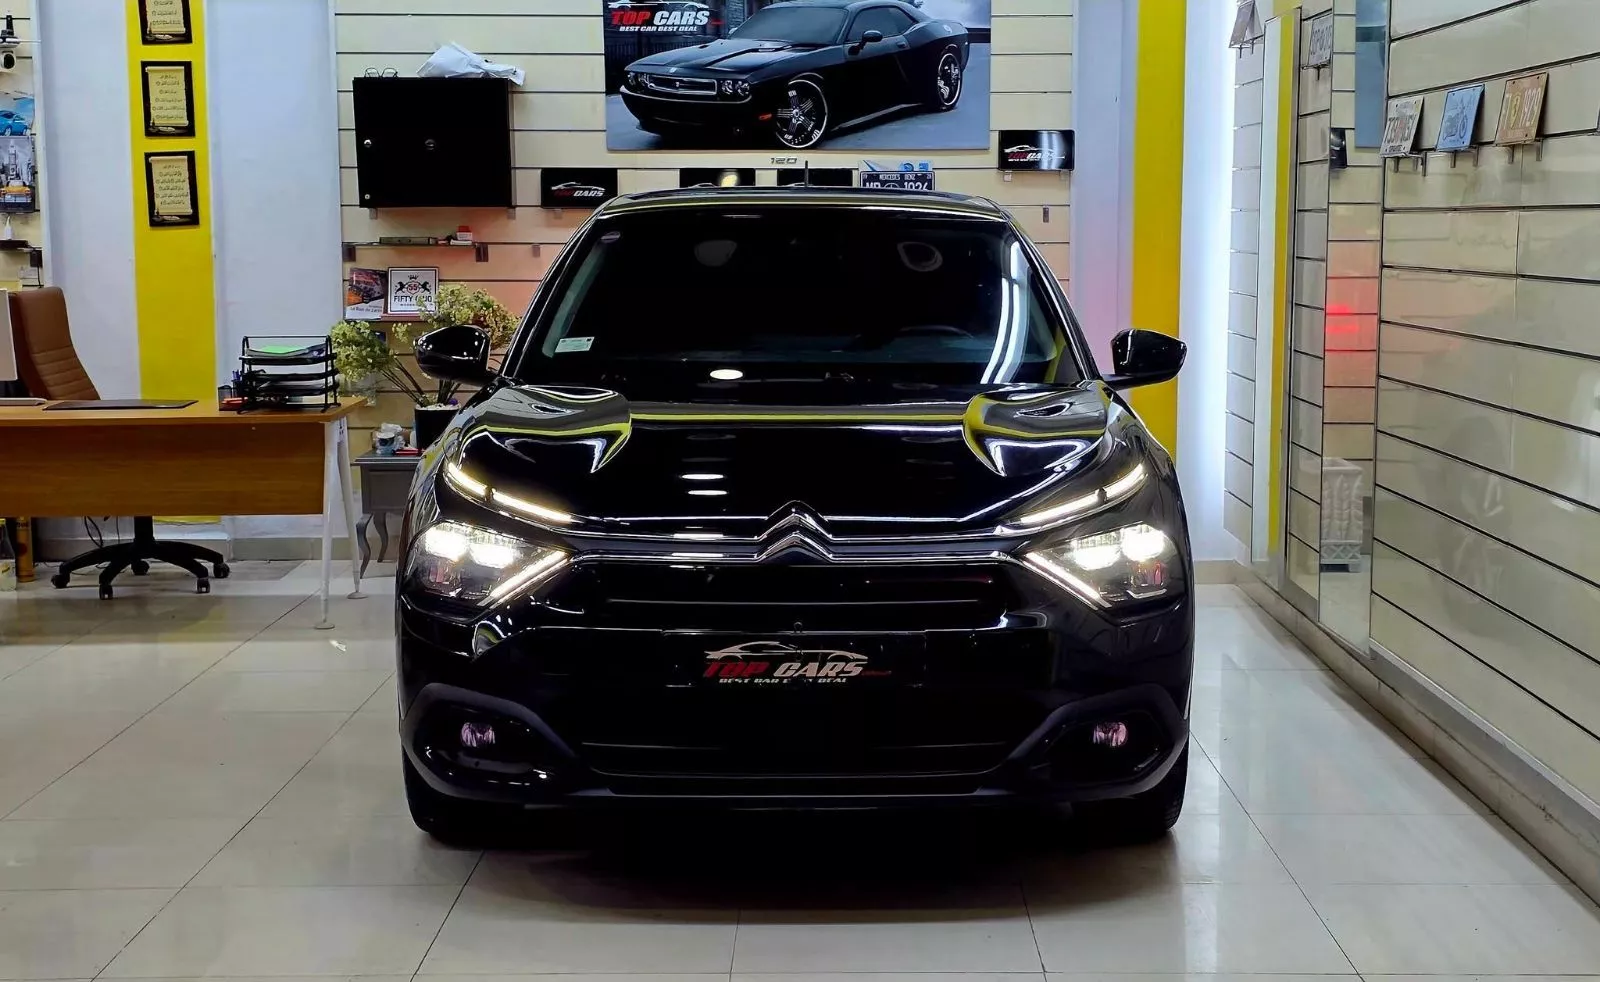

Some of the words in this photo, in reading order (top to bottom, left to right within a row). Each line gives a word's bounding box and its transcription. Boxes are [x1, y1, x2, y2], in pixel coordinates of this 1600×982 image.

[611, 10, 651, 26] TOP
[653, 10, 710, 26] CARS
[393, 295, 413, 303] FIFTY
[703, 661, 770, 677] TOP
[773, 661, 868, 677] CARS
